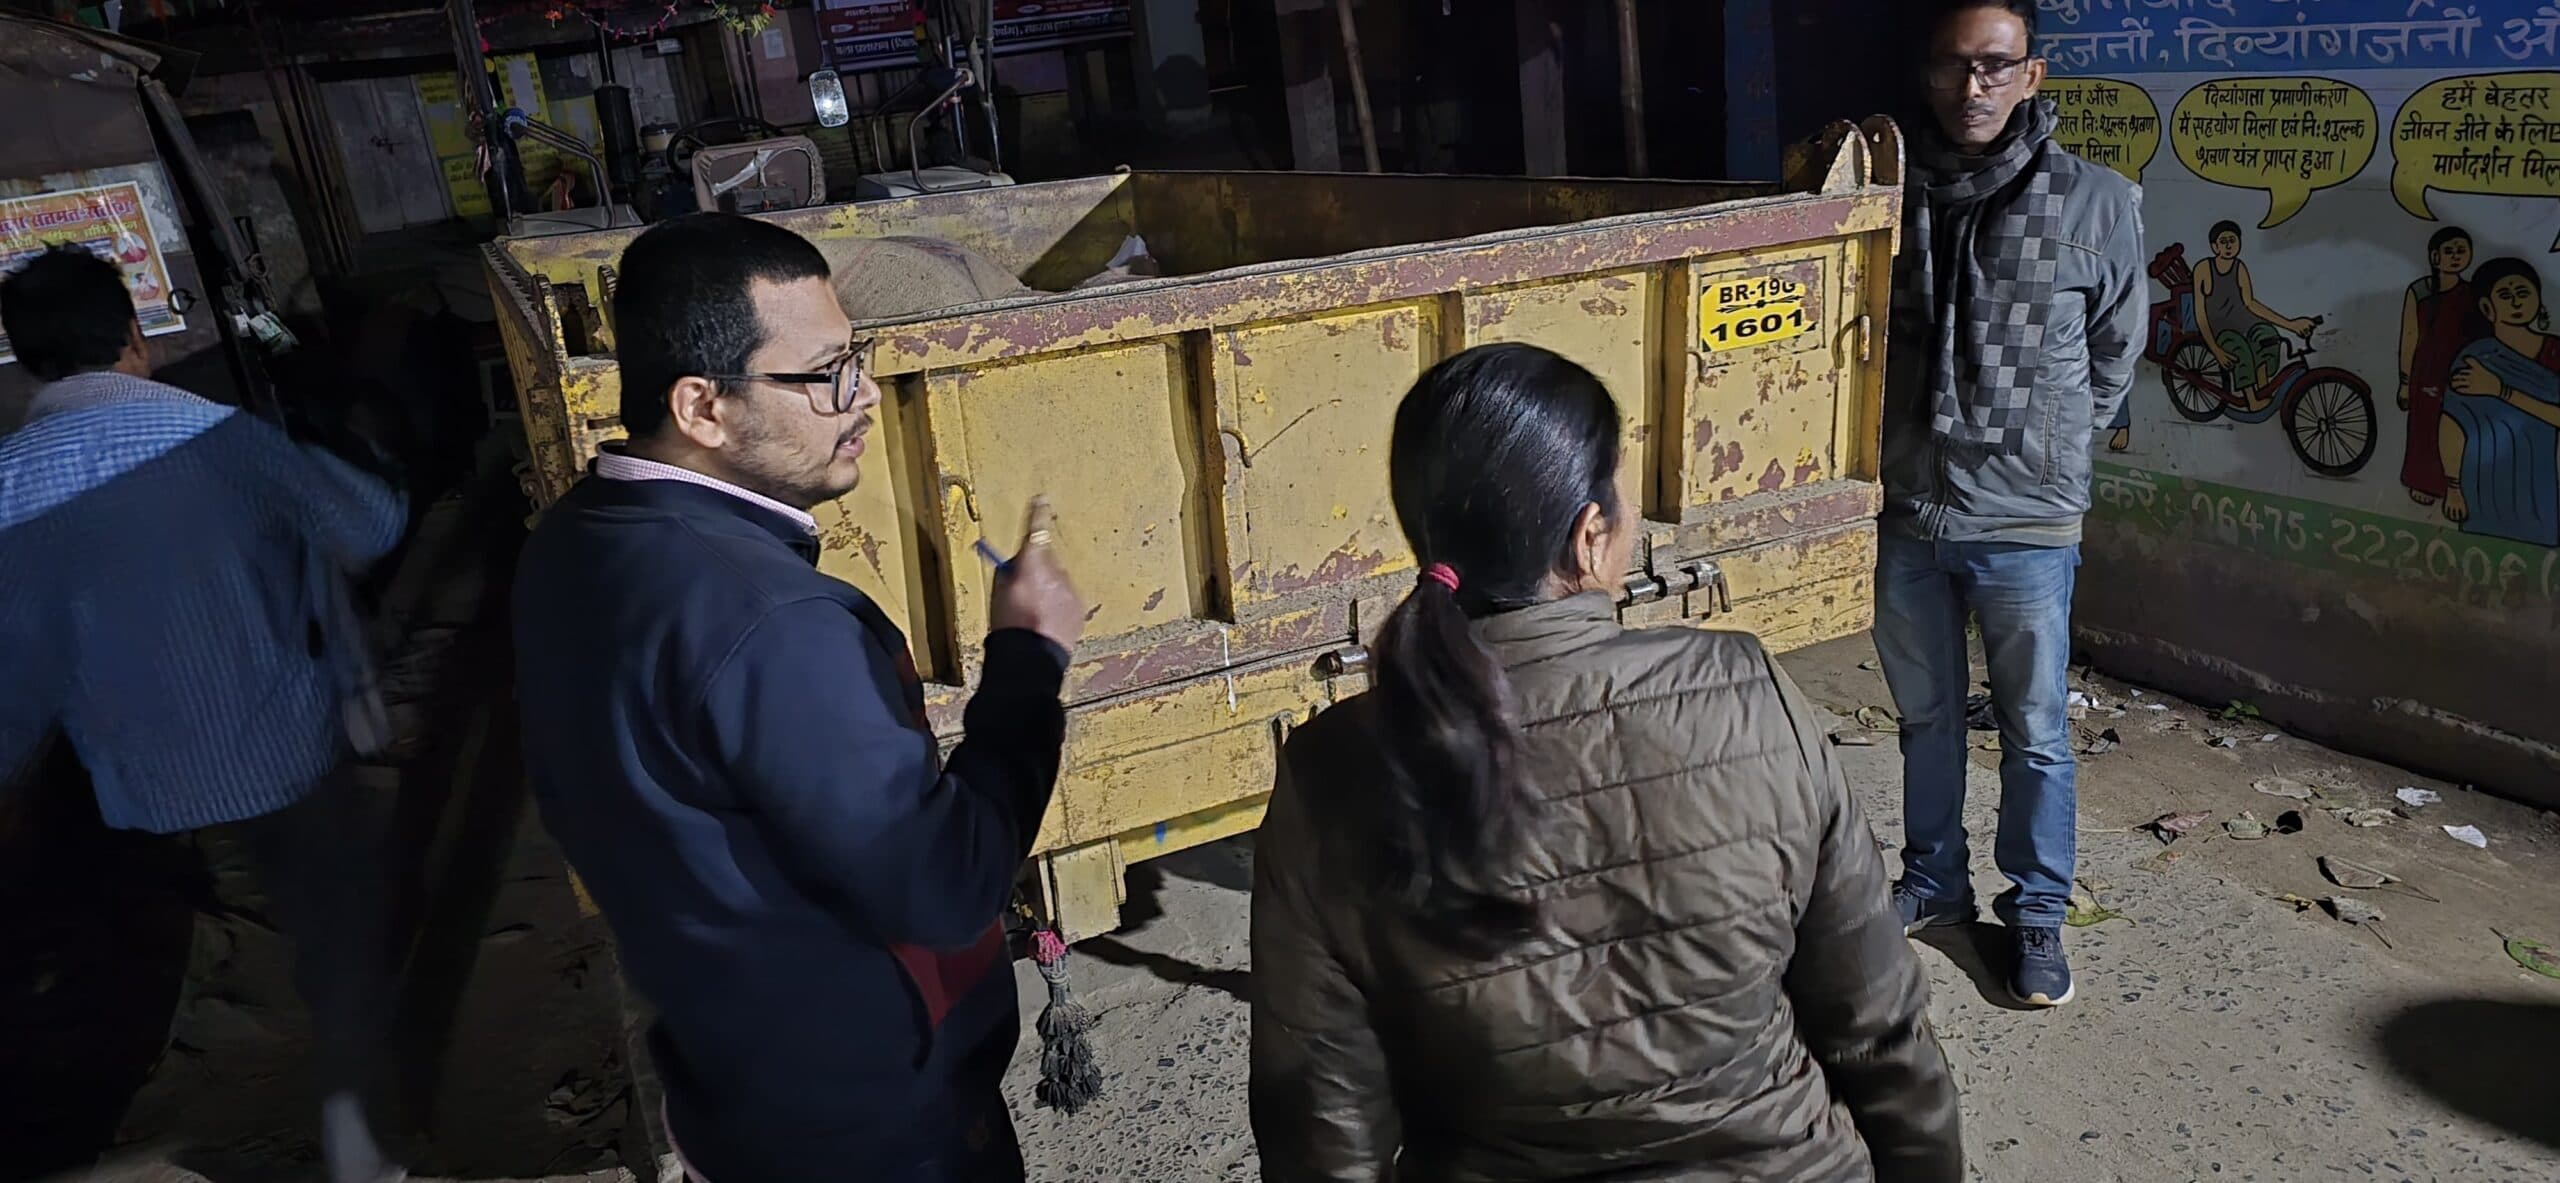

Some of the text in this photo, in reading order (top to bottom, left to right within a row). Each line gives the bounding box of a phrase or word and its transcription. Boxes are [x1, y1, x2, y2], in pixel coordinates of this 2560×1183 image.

[2173, 5, 2482, 68] दिव्यांगजनों
[2066, 84, 2082, 106] एवं
[2203, 81, 2349, 113] दिव्यांगता प्रमाणीकरण
[2441, 80, 2551, 112] हमें बेहतर
[2192, 111, 2240, 141] सहयोग
[2243, 110, 2279, 140] मिला
[2281, 112, 2300, 138] एवं
[2400, 110, 2451, 142] जीवन
[2454, 112, 2490, 142] जीने
[2495, 114, 2515, 144] के
[2263, 149, 2297, 176] प्राप्त
[2301, 149, 2334, 180] हुआ
[2433, 146, 2515, 185] मार्गदर्शन
[1709, 308, 1802, 342] 1601
